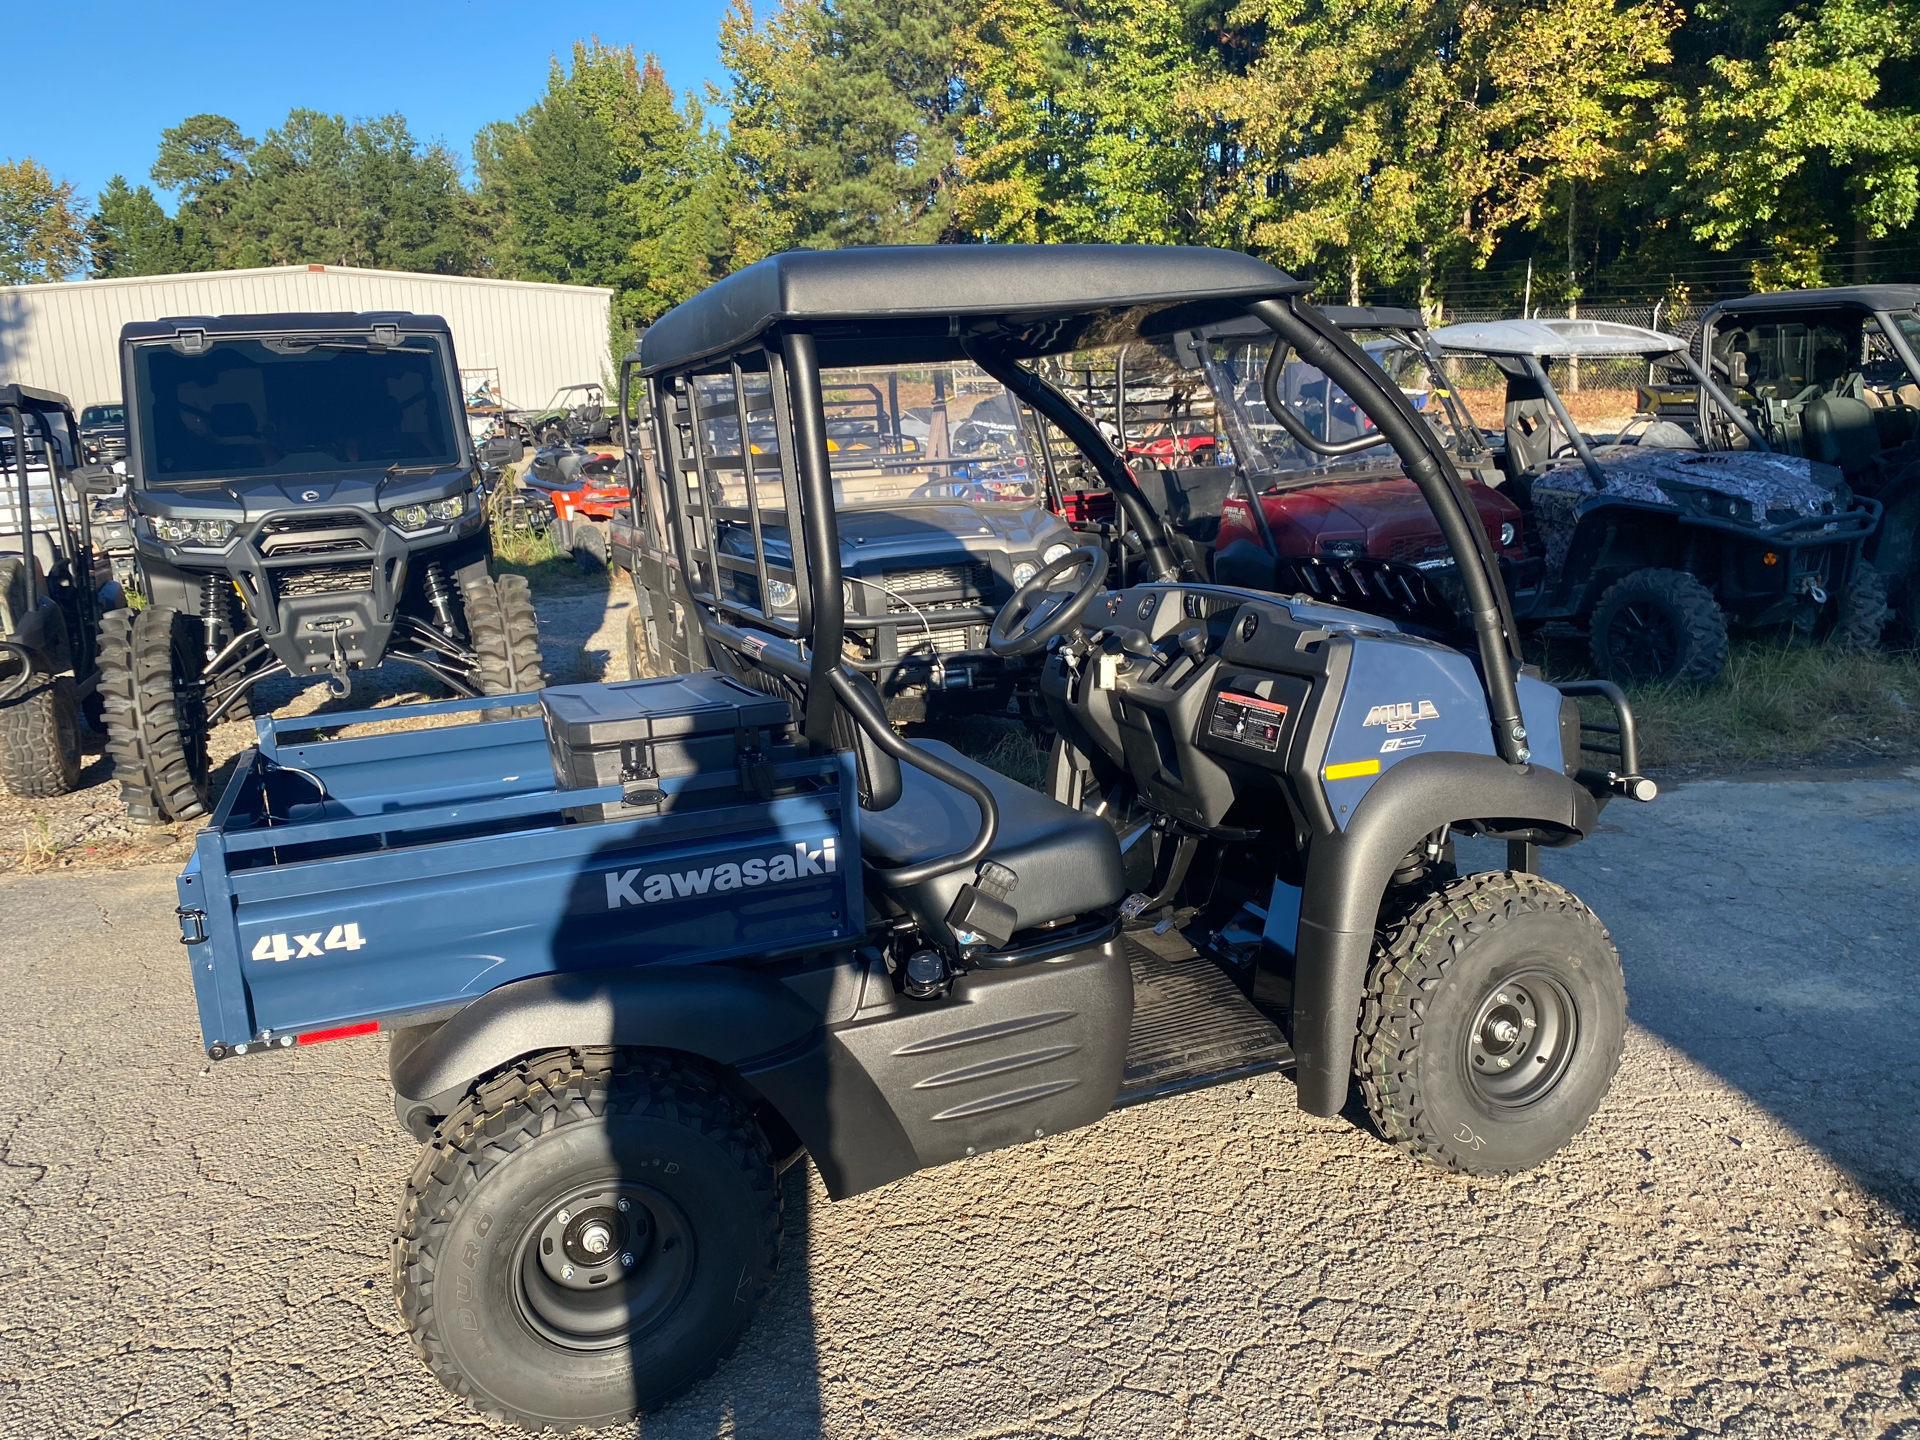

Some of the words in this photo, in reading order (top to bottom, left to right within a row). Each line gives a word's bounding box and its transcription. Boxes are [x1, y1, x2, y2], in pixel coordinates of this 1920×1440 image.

[1363, 700, 1440, 727] MULE
[1387, 720, 1417, 733] SX
[1384, 741, 1398, 750] FI
[604, 838, 836, 909] Kawasaki
[251, 922, 367, 962] 4x4
[456, 1212, 495, 1331] DURO
